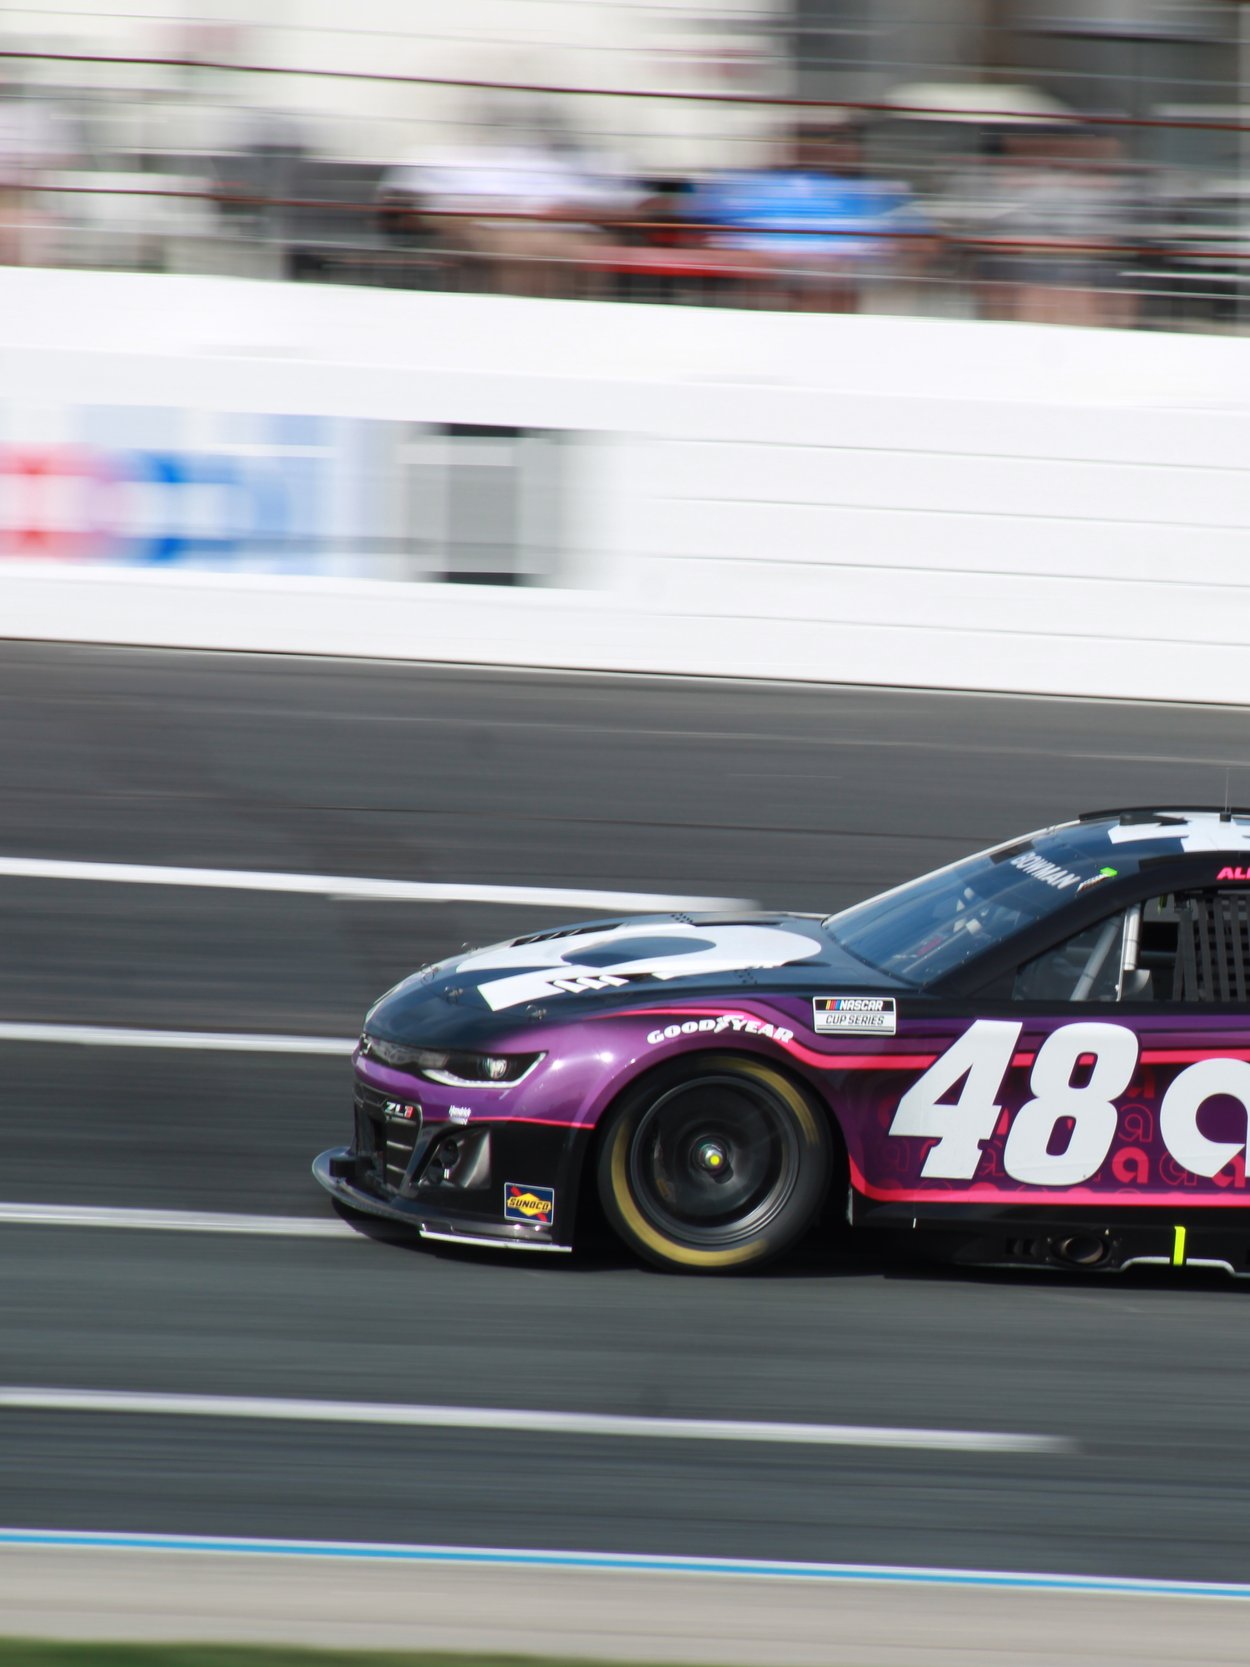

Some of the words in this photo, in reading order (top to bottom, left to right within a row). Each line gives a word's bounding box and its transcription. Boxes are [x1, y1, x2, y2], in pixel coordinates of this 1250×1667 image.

[1010, 851, 1081, 890] BOWMAN
[839, 999, 884, 1011] NASCAR
[646, 1014, 794, 1044] GOODYEAR
[825, 1014, 847, 1025] CUP
[848, 1015, 885, 1026] SERIES
[888, 1019, 1139, 1186] 48
[509, 1197, 549, 1211] SUNOCO
